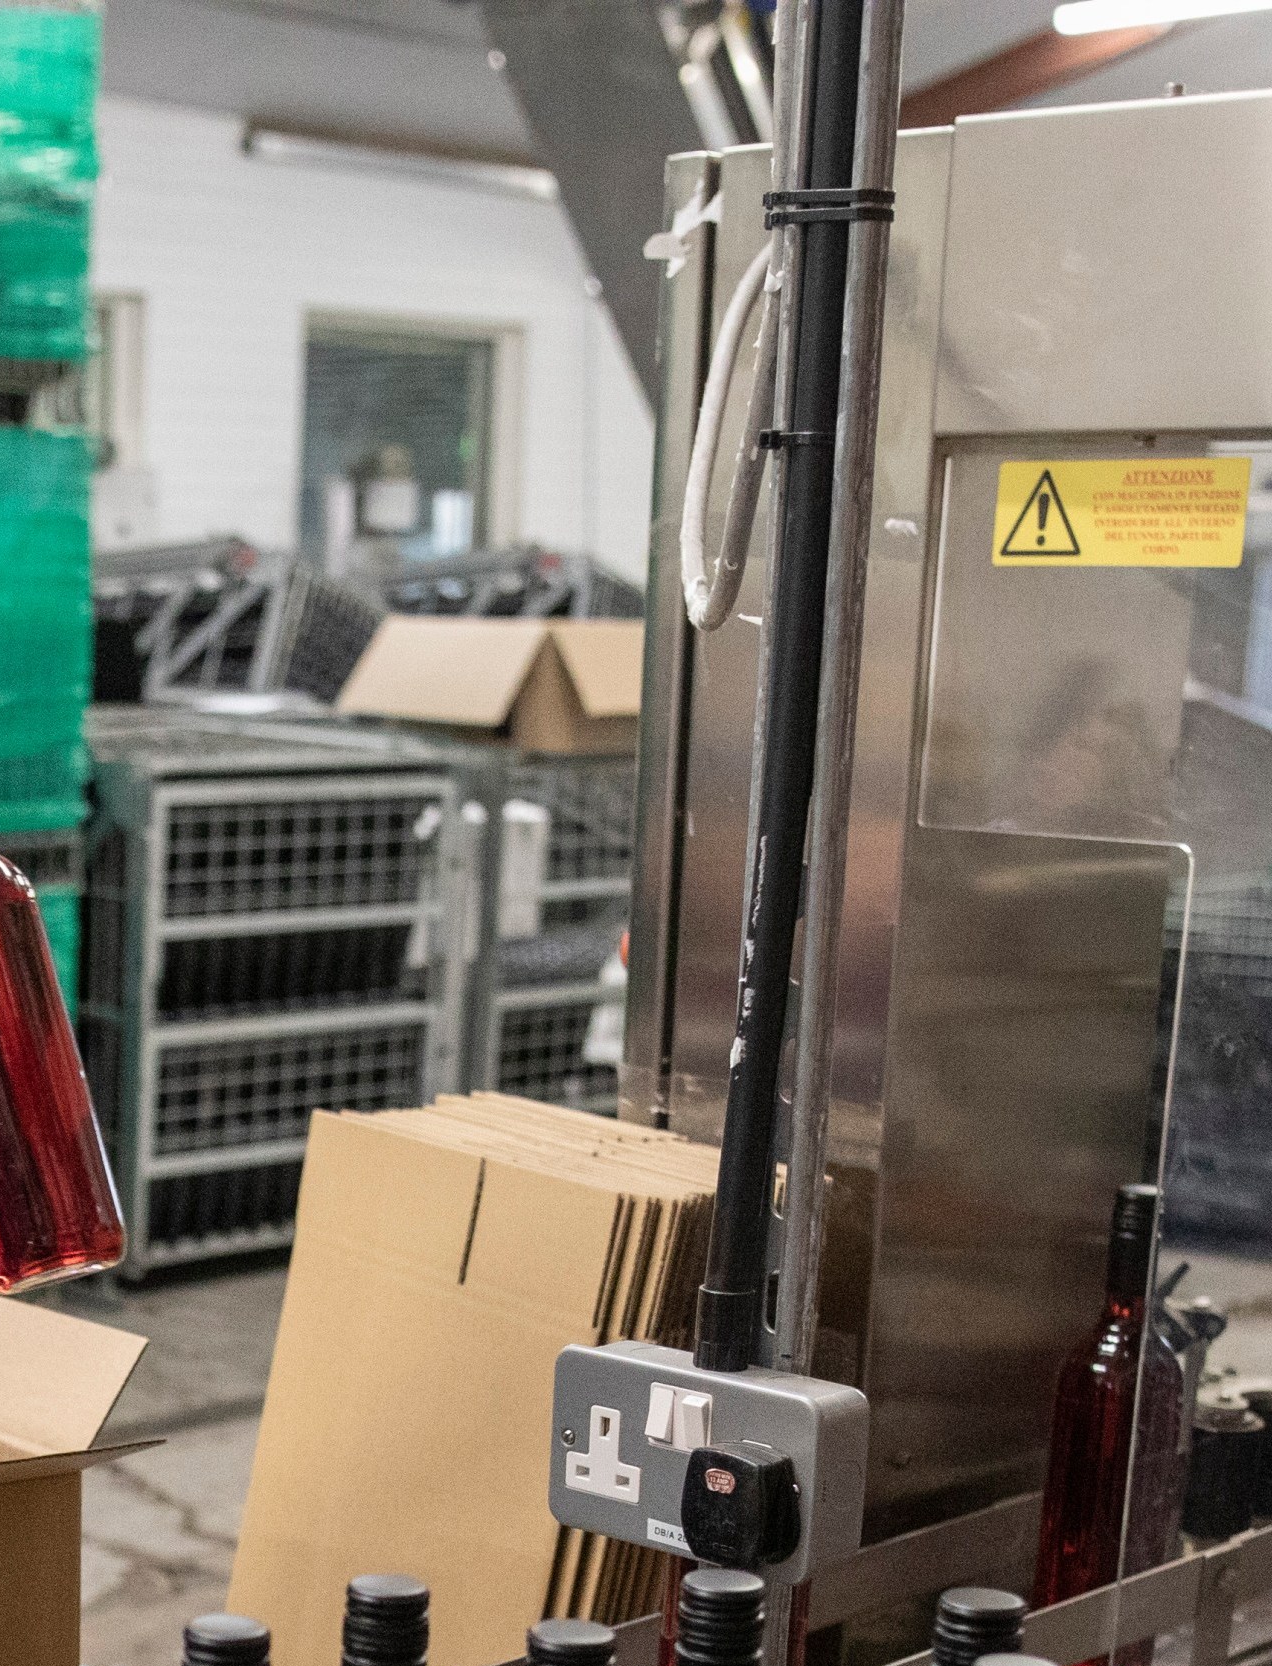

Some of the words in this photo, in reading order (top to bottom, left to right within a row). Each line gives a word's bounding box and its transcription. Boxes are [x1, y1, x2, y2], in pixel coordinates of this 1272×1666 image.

[1122, 470, 1214, 485] ATTENZIONE
[1092, 491, 1115, 500] CON
[1117, 491, 1173, 500] MACCHINA
[1188, 490, 1241, 500] FUNZIONE
[1105, 504, 1191, 513] ASSOLUTAMENTE
[1188, 518, 1236, 527] INTERNO
[1104, 532, 1123, 541] DEL
[1201, 532, 1221, 541] DEL
[654, 1526, 674, 1540] DB/A
